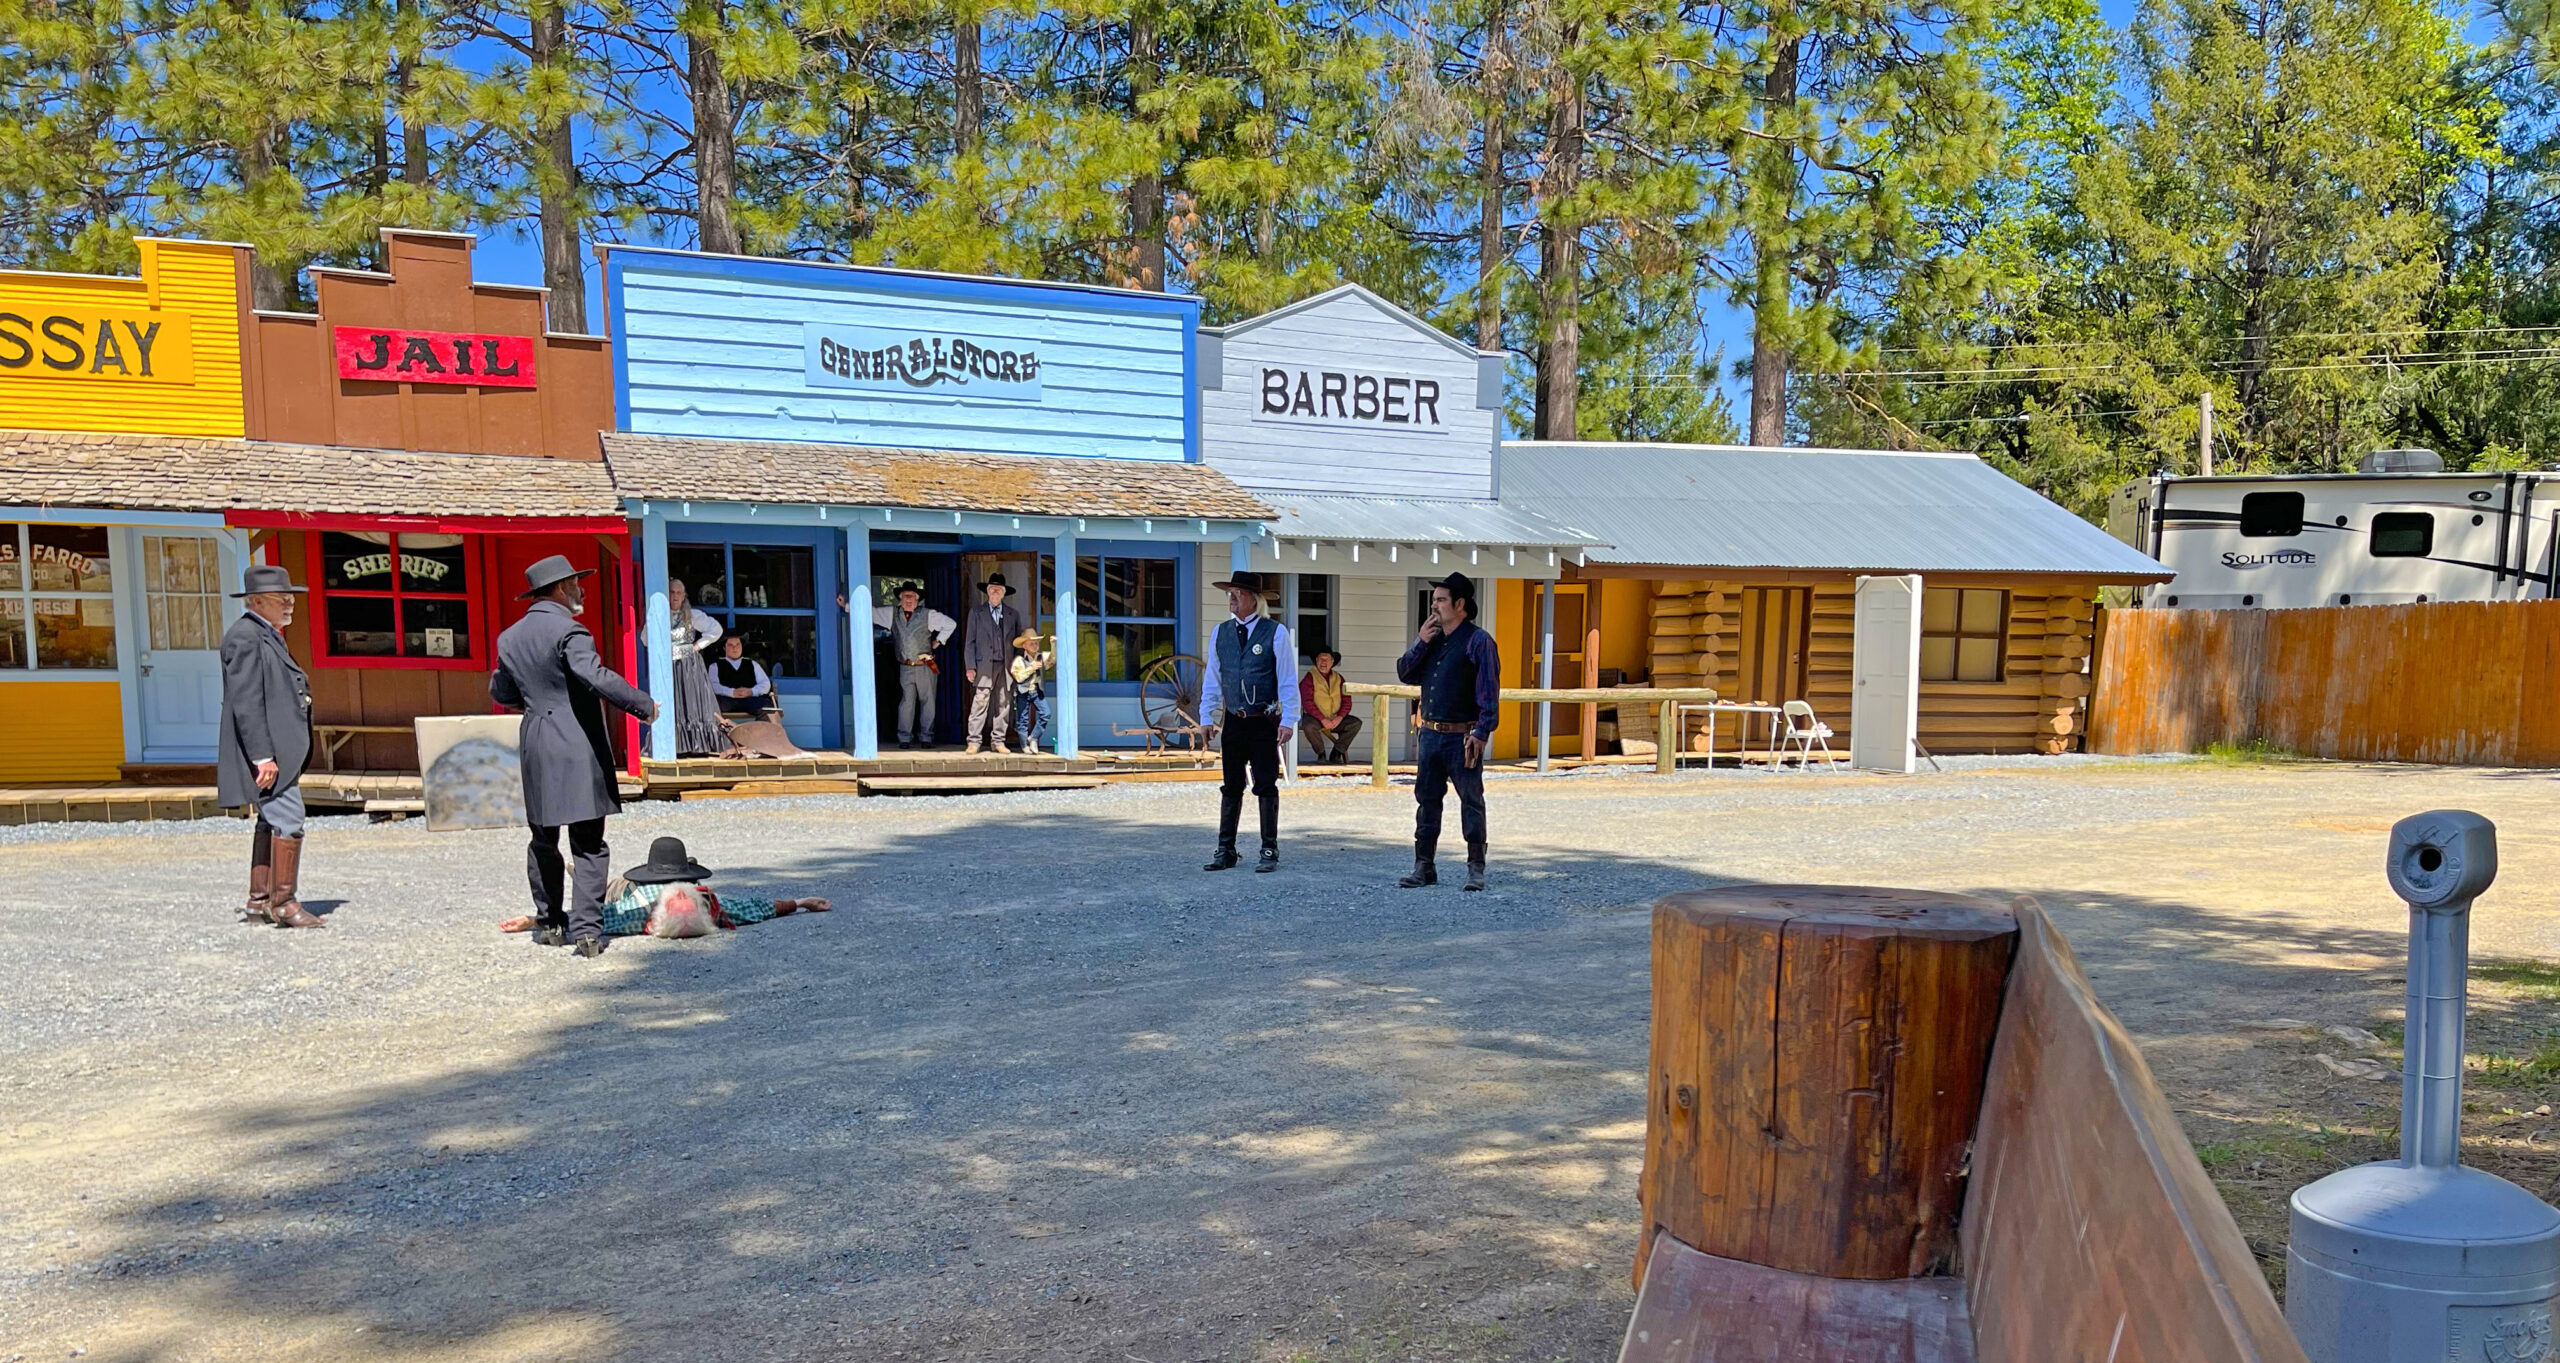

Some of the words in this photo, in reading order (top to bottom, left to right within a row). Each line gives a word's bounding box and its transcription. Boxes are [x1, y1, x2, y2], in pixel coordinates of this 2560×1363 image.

[355, 335, 518, 377] JAIL
[820, 336, 952, 387] GENERAL
[951, 338, 1041, 384] STORE
[1261, 367, 1441, 425] BARBER
[33, 544, 95, 575] FARGO
[343, 553, 450, 581] SHERIFF
[2221, 552, 2316, 566] SOLITUDE
[0, 599, 71, 615] XPRESS
